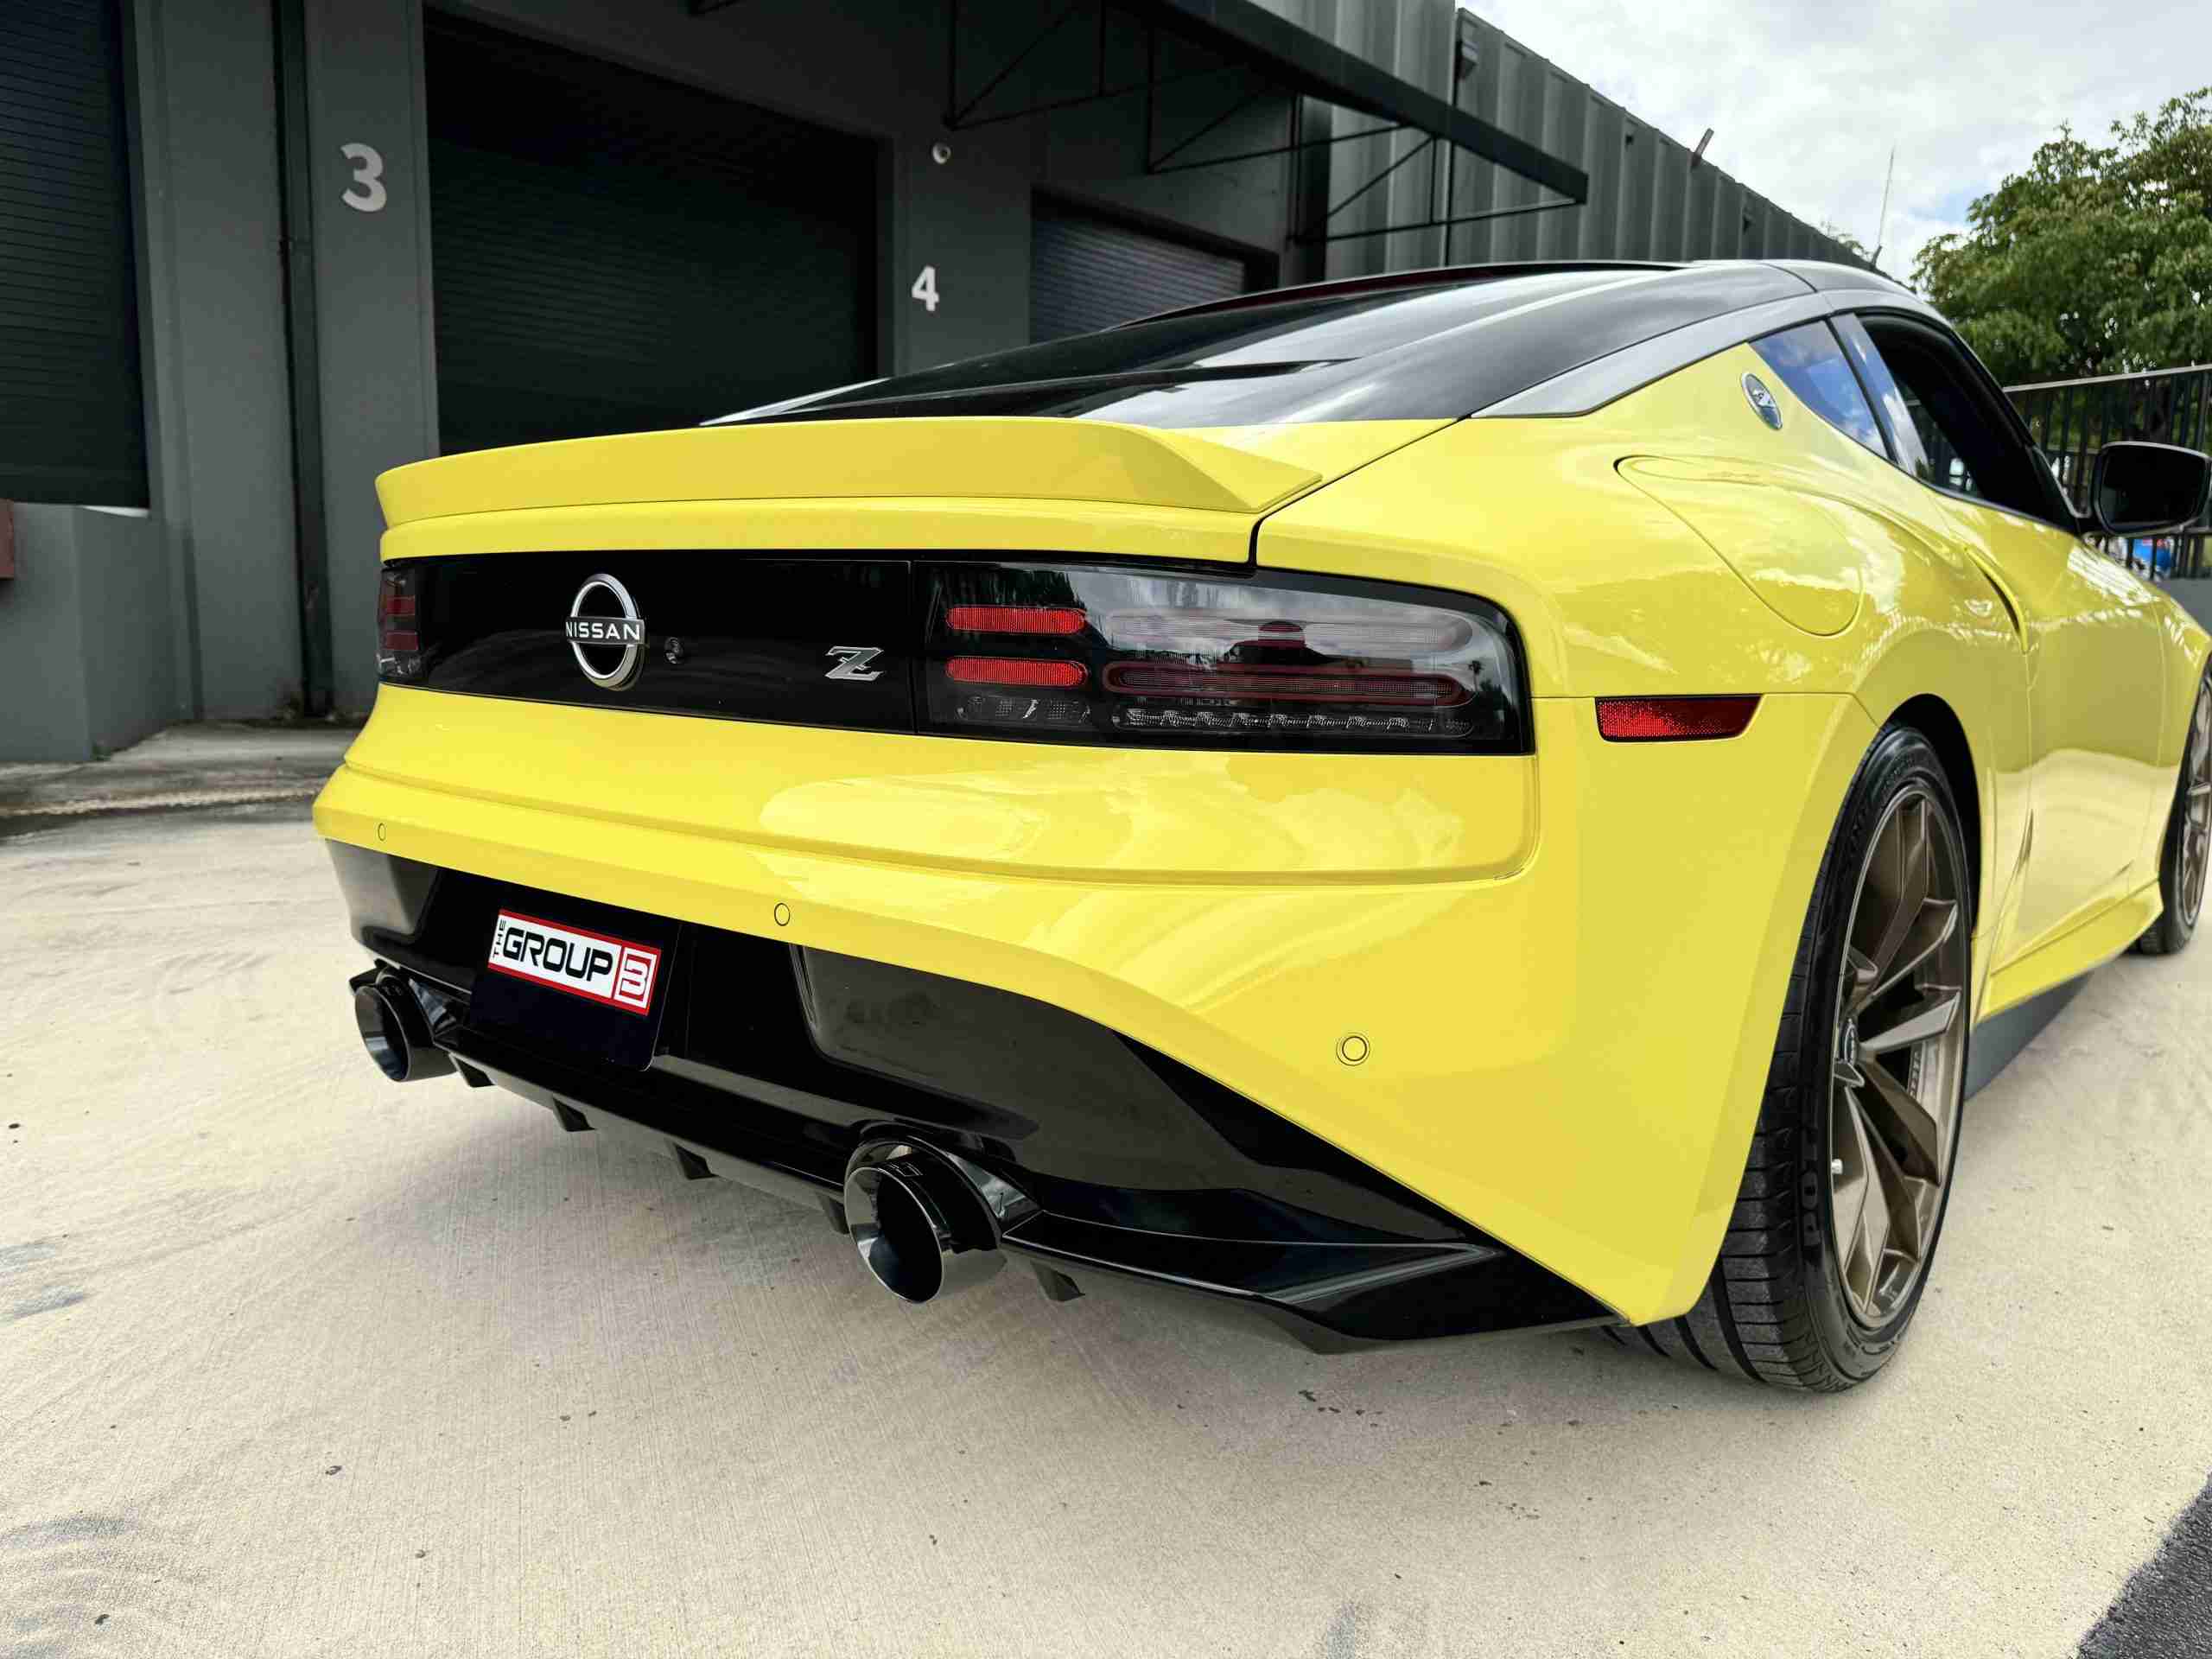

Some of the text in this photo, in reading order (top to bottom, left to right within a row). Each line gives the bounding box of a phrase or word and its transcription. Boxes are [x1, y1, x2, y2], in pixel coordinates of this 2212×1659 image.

[340, 143, 386, 213] 3
[912, 264, 939, 311] 4
[565, 620, 640, 640] NISSAN
[824, 645, 885, 681] Z
[493, 918, 506, 959] THE
[503, 926, 613, 982] GROUP
